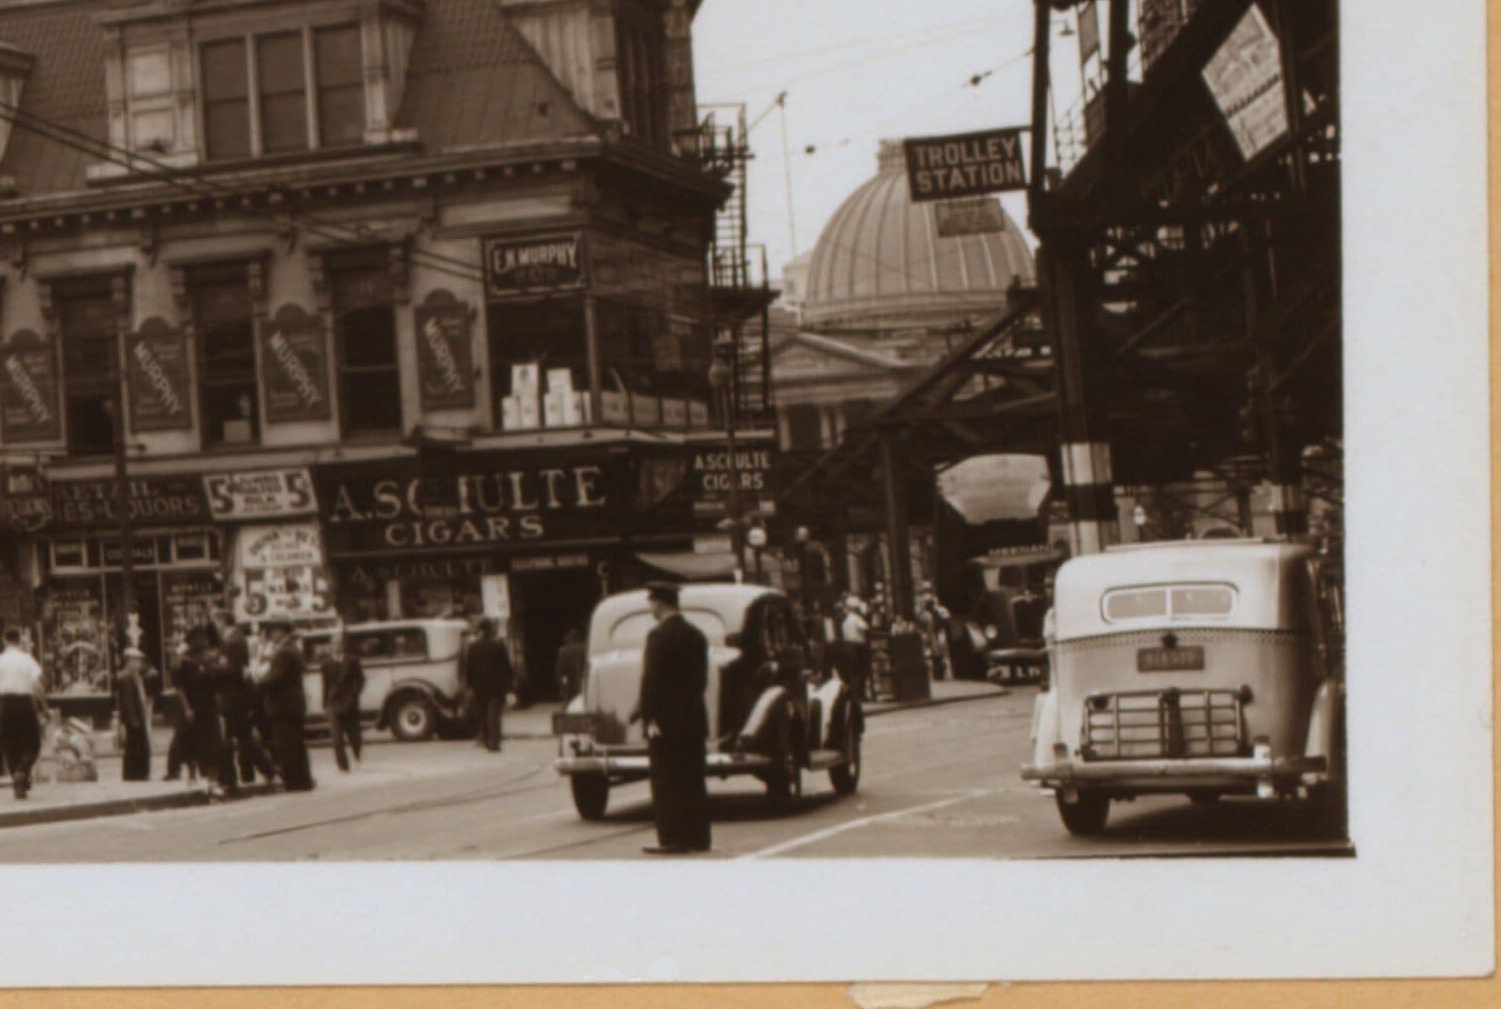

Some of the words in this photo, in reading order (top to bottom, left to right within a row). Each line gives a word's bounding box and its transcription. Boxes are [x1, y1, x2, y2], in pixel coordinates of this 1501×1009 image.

[913, 136, 1015, 167] TROLLEY
[916, 160, 1021, 193] STATION
[134, 341, 184, 415] MURPHY
[269, 330, 320, 408] MURPHY
[6, 353, 51, 424] MURPHY
[702, 472, 764, 490] CIGRS
[385, 514, 543, 546] CIGARS
